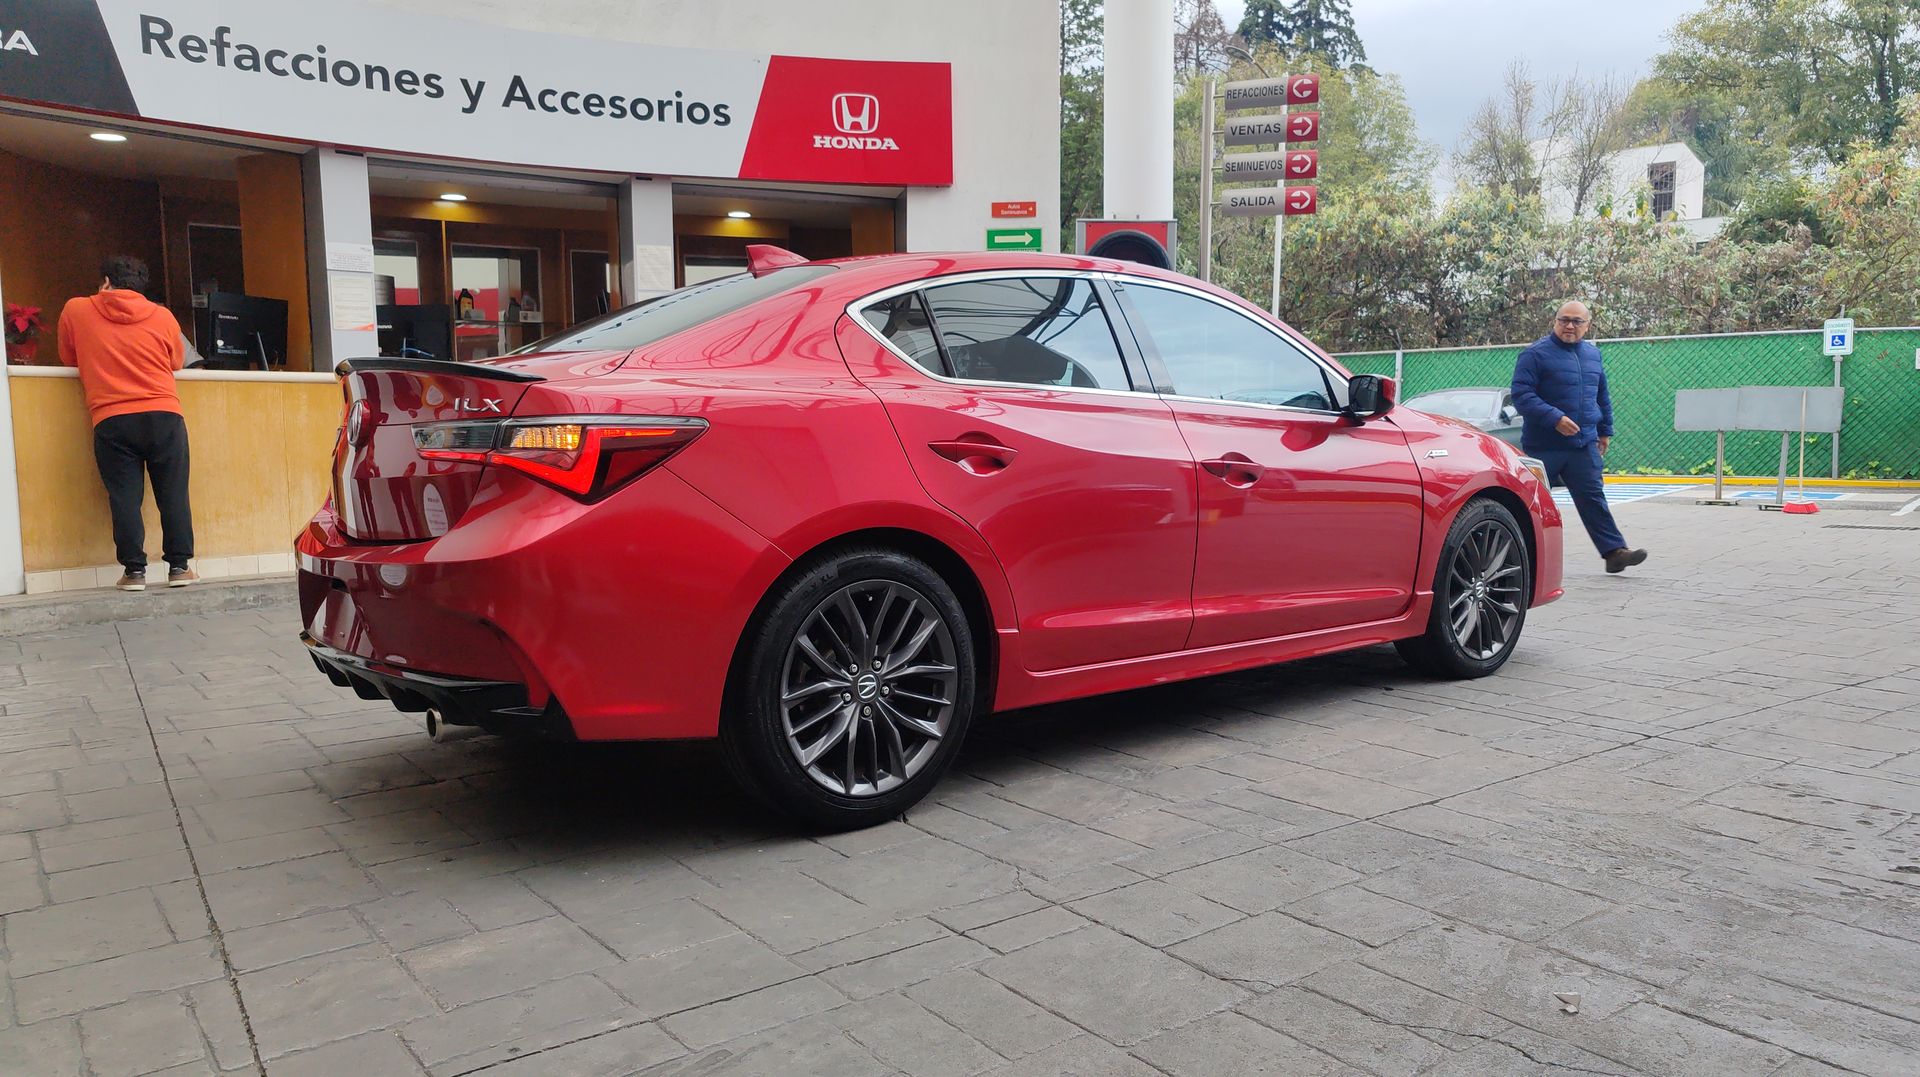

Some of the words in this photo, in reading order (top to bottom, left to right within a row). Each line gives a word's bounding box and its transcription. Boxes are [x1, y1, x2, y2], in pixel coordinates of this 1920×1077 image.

[0, 29, 39, 56] A
[139, 13, 446, 99] Refacciones
[459, 77, 487, 114] y
[501, 74, 732, 127] Accesorios
[1226, 84, 1285, 101] REFACCIONES
[1230, 122, 1282, 137] VENTAS
[813, 135, 900, 151] HONDA
[1225, 159, 1284, 173] SEMINUEVOS
[1230, 195, 1276, 208] SALIDA
[454, 397, 504, 413] ILX
